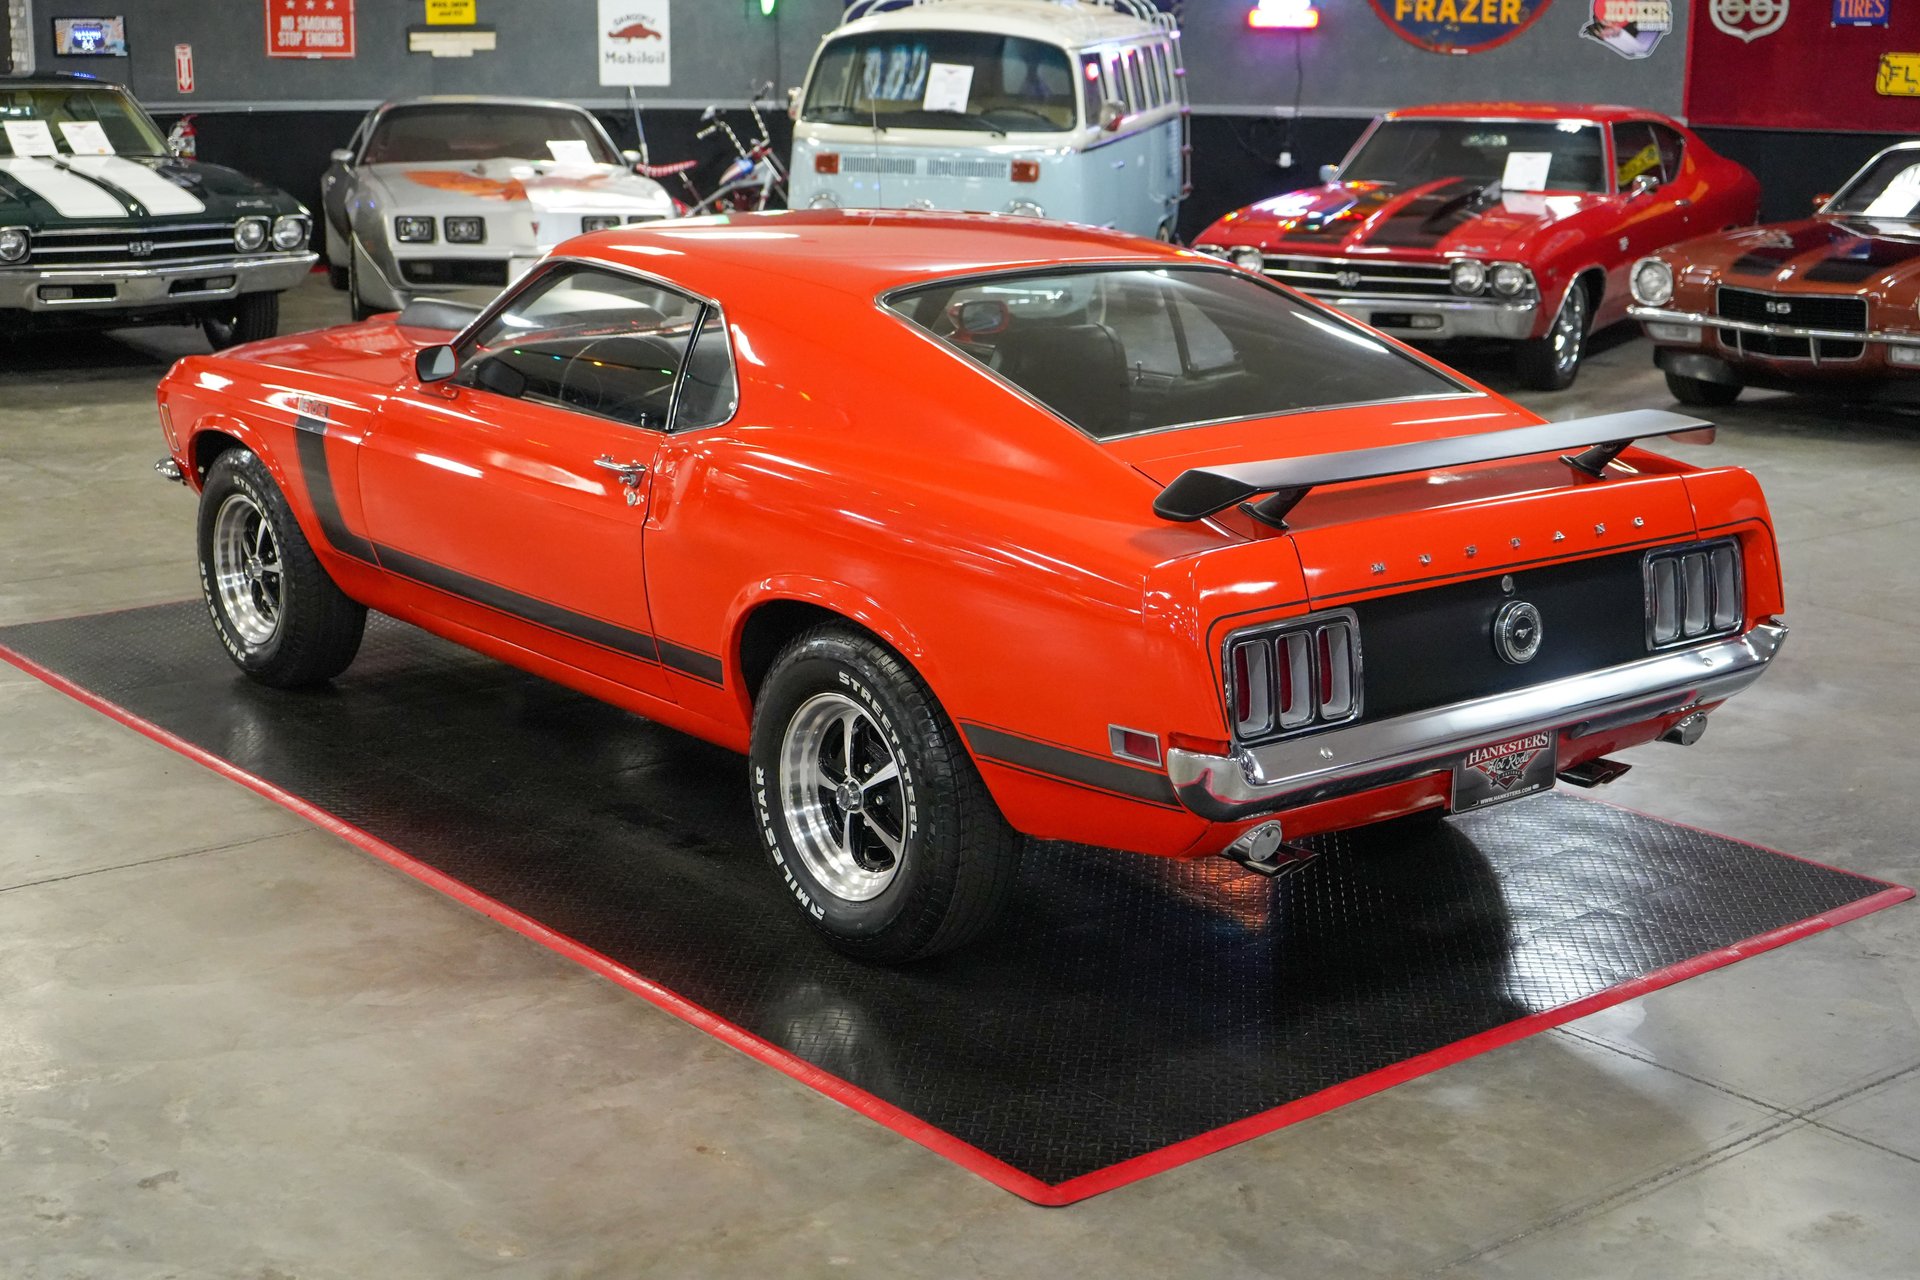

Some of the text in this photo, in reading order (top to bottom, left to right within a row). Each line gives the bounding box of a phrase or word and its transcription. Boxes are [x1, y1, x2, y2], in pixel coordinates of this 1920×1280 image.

[1394, 0, 1522, 24] FRAZER
[1838, 0, 1886, 18] TIRES
[280, 15, 344, 32] NO SMOKING
[277, 31, 345, 47] STOP ENGINES
[604, 51, 665, 64] Mobiloil
[1370, 516, 1645, 575] MUSTANG
[1468, 730, 1549, 765] HANKSTERS
[1486, 756, 1506, 775] Hot
[755, 766, 811, 907] MILESTAR
